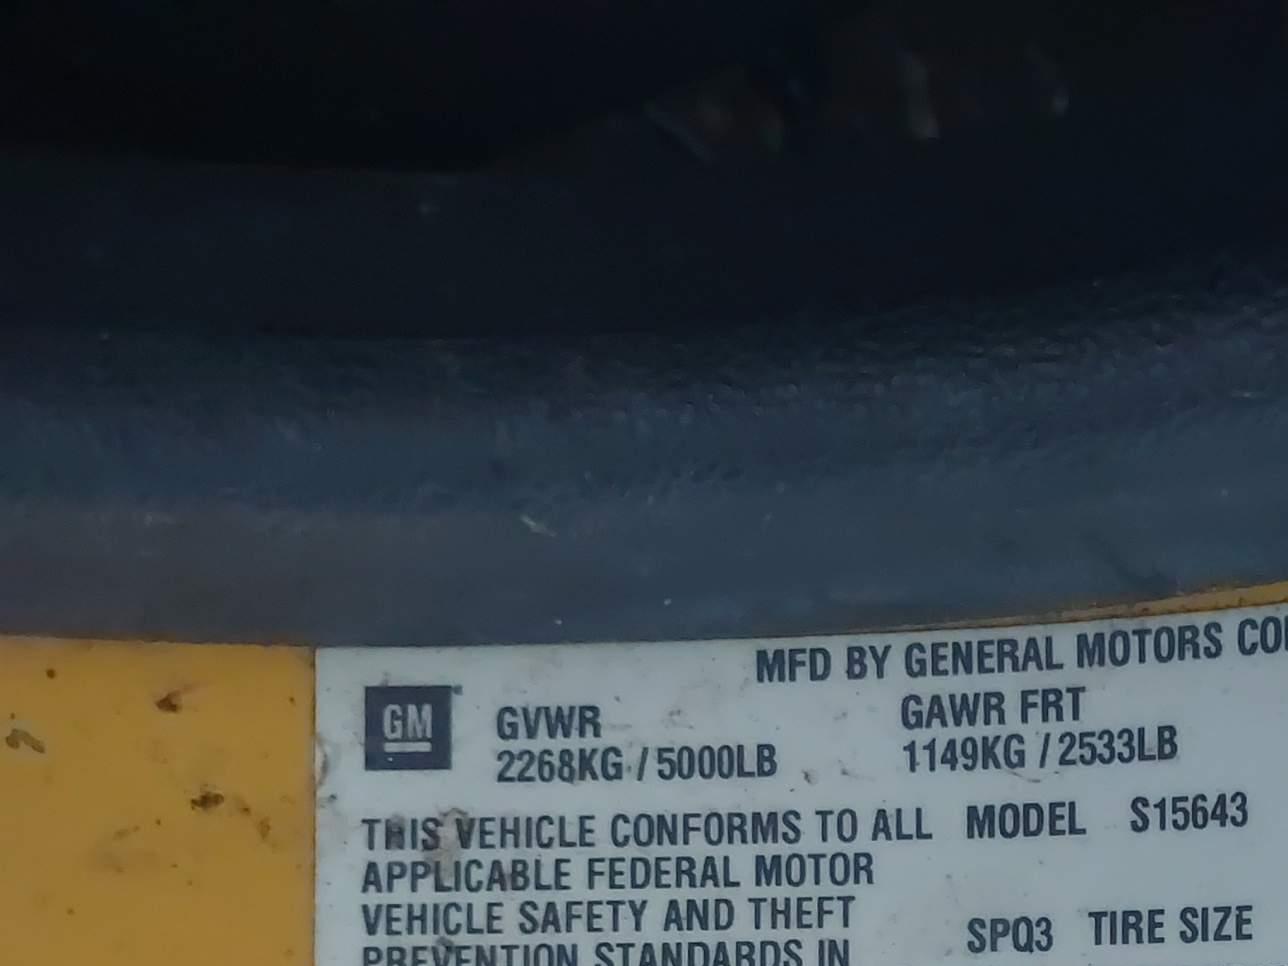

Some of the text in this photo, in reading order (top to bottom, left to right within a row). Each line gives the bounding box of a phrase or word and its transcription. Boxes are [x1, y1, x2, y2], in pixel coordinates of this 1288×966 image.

[756, 648, 831, 683] MFD
[846, 645, 891, 679] BY
[905, 634, 1064, 679] GENERAL
[1077, 622, 1222, 668] MOTORS
[384, 704, 432, 740] GM
[497, 705, 601, 740] GVWR
[901, 686, 1086, 730] GAWR FRT
[497, 744, 777, 784] 2268KG / 5000LB
[903, 725, 1177, 773] 1149KG / 2533LB
[361, 808, 932, 852] THIS VEHICLE CONFORMS TO ALL
[967, 792, 1248, 839] MODEL S15643
[362, 852, 873, 893] APPLICABLE FEDERAL MOTOR
[362, 896, 855, 936] VEHICLE SAFETY AND THEFT
[967, 916, 1053, 954] SPQ3
[1088, 909, 1165, 945] TIRE
[1180, 905, 1252, 943] SIZE
